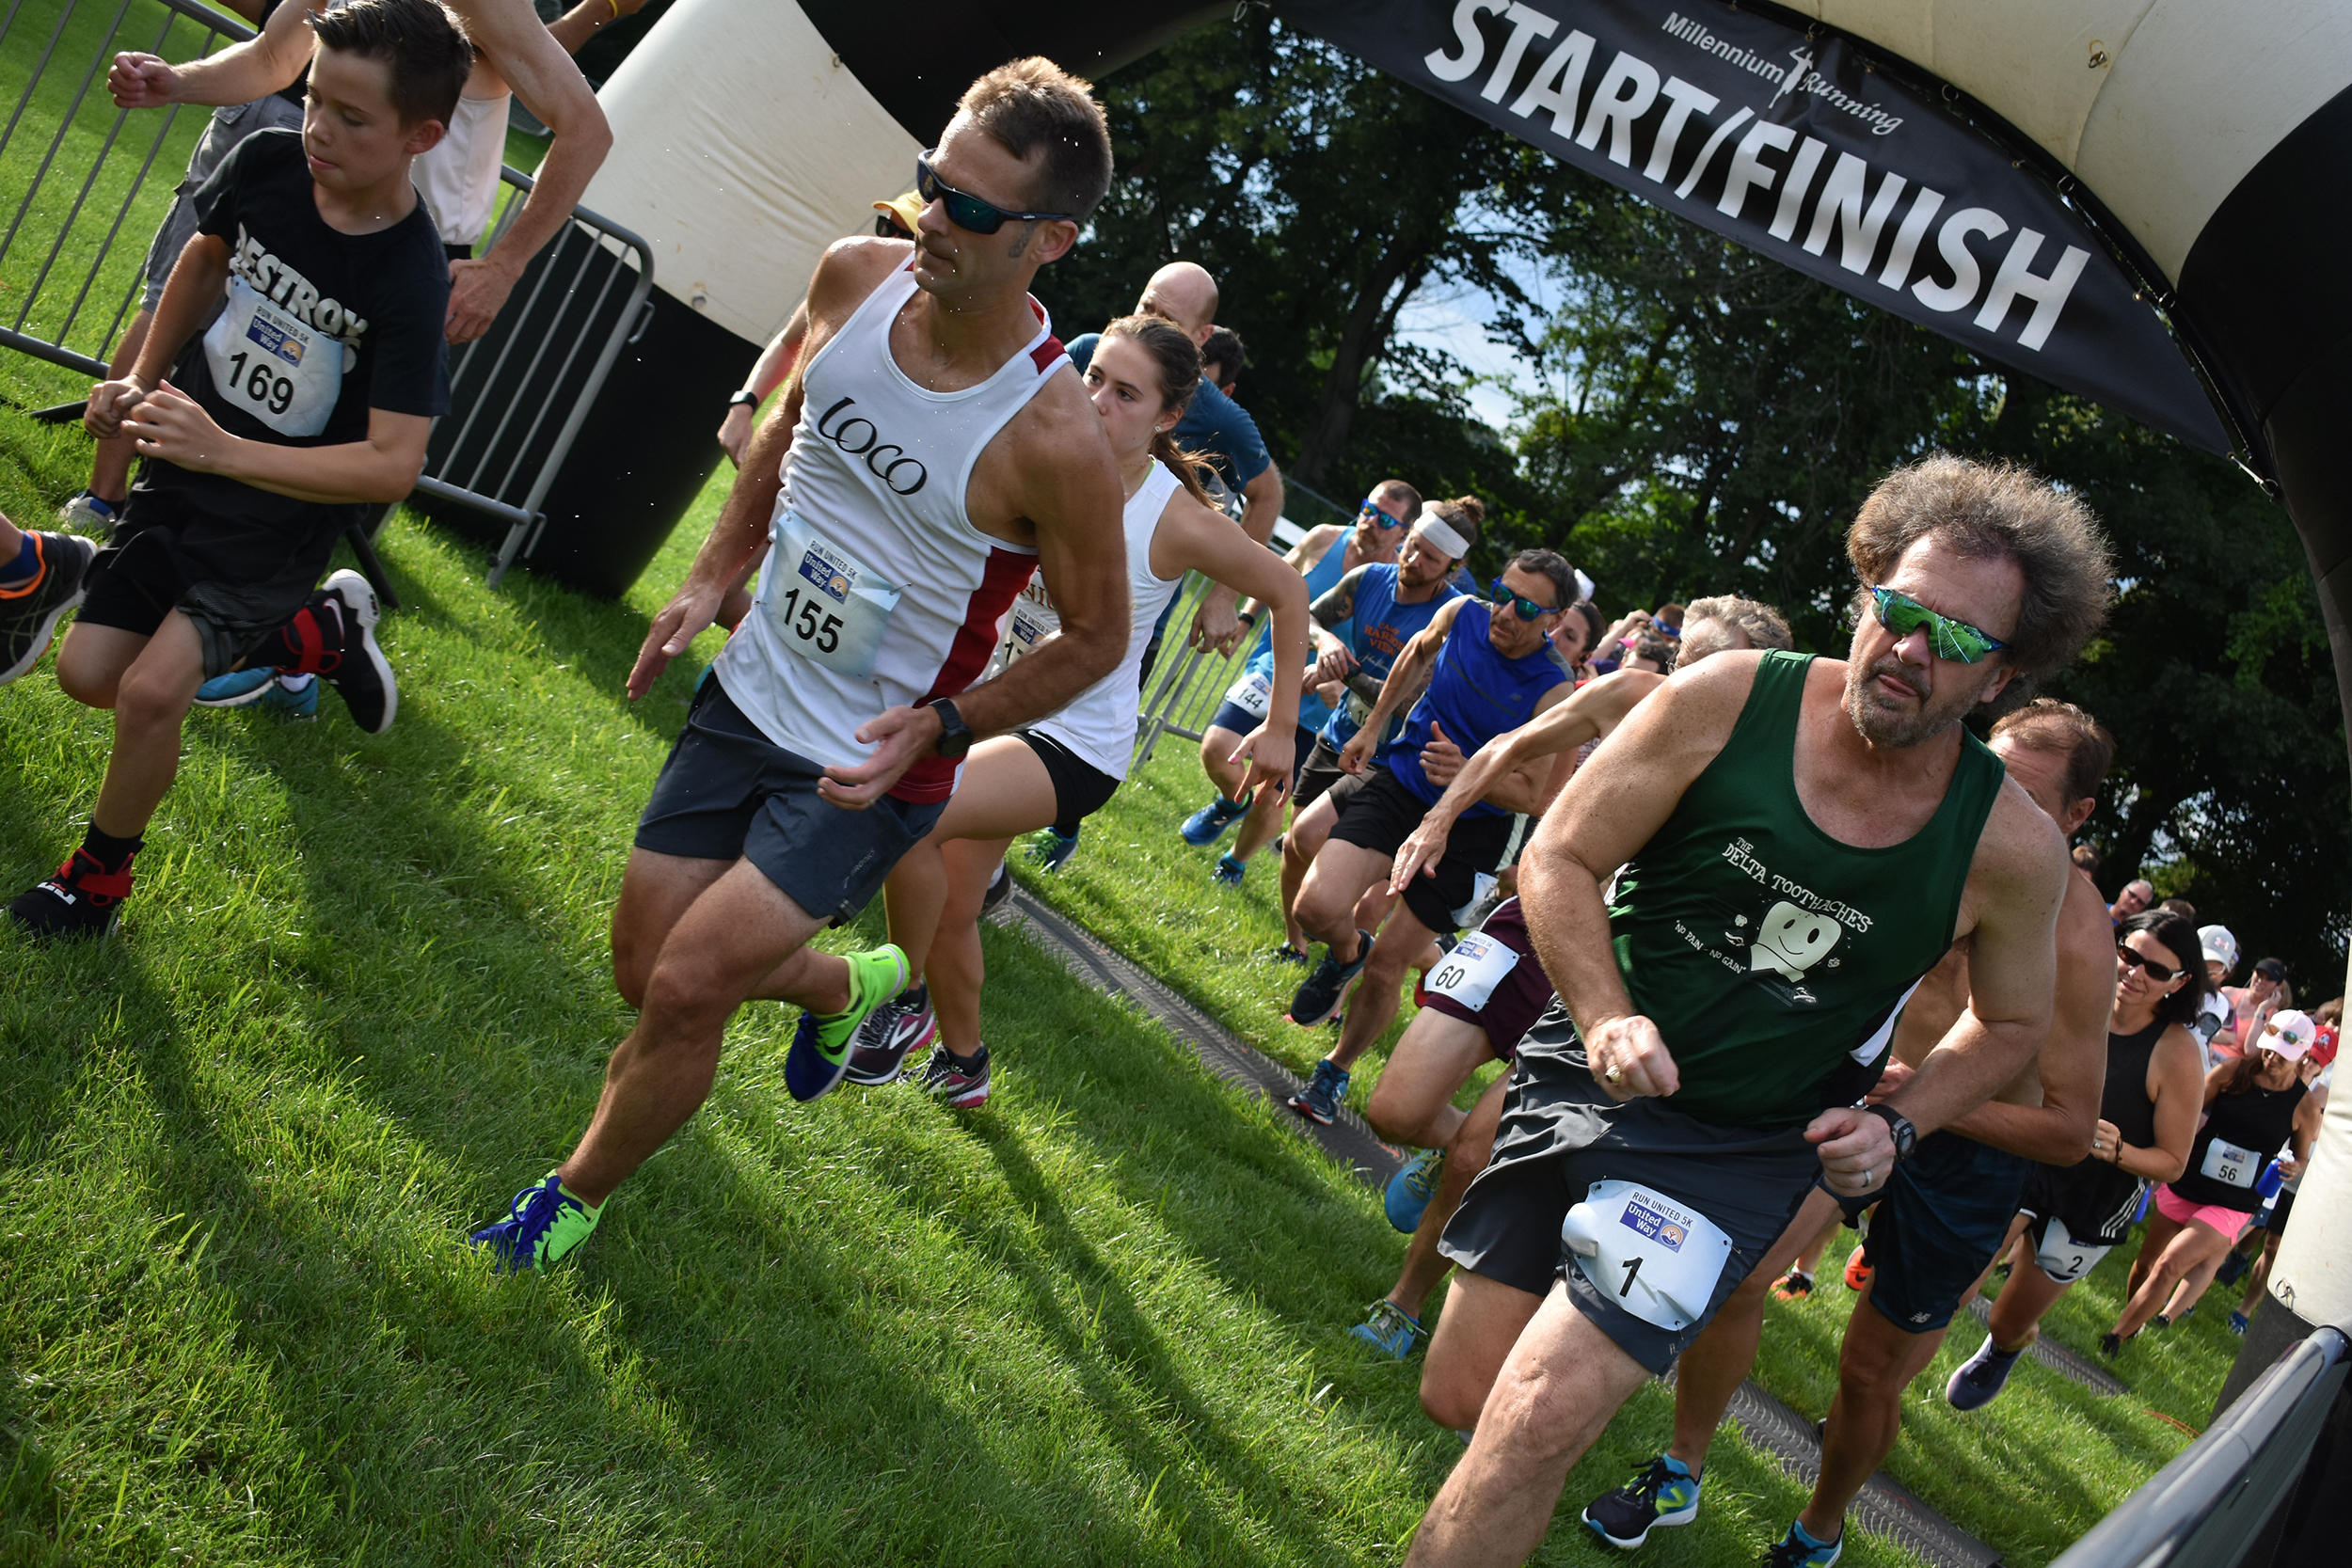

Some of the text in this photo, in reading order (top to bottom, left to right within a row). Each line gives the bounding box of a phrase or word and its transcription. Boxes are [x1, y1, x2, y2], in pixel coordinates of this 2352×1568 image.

[1661, 11, 1903, 136] Millennium Running
[1423, 0, 2091, 353] START/FINISH
[252, 318, 282, 342] United
[256, 305, 310, 344] RUN UNITED 5K
[260, 333, 278, 352] Way
[230, 351, 294, 414] 169
[818, 396, 928, 496] LOCO
[804, 553, 833, 578] United
[809, 540, 858, 579] RUN UNITED 5K
[810, 568, 827, 588] Way
[784, 587, 844, 654] 155
[1015, 618, 1035, 636] United
[1027, 616, 1047, 633] UNITED
[1019, 629, 1032, 642] Way
[1005, 641, 1024, 666] 1
[1238, 689, 1263, 709] 144
[1736, 837, 1754, 853] THE
[1722, 843, 1873, 933] DELTA TOOTHACHES
[1684, 931, 1704, 951] PAIN
[1709, 949, 1723, 958] NO
[1435, 965, 1465, 990] 60
[2218, 1164, 2237, 1181] 56
[1628, 1203, 1661, 1227] United
[1632, 1191, 1693, 1227] RUN UNITED 5K
[1636, 1218, 1657, 1237] Way
[2067, 1255, 2083, 1274] 2
[1619, 1257, 1644, 1298] 1
